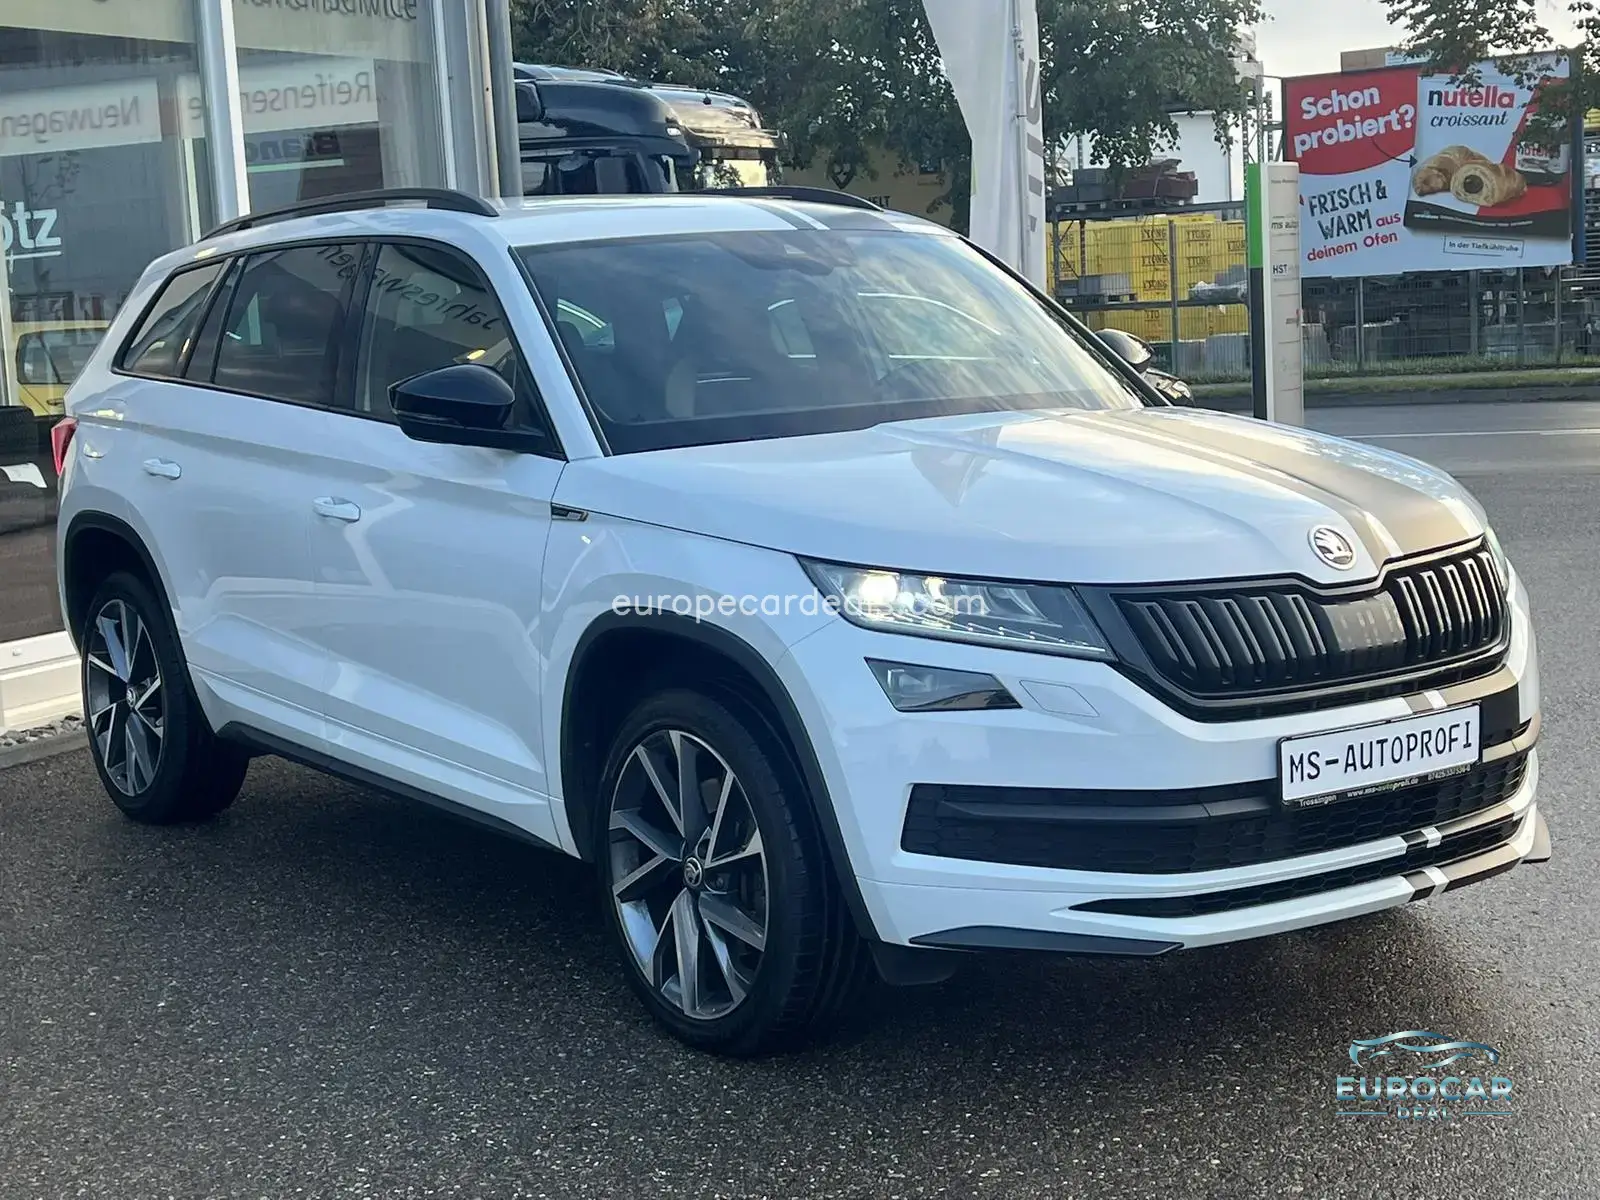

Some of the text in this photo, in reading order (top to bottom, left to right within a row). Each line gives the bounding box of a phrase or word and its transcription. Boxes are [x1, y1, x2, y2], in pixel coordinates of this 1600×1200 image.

[1301, 87, 1380, 119] Schon
[1428, 85, 1515, 108] nutella
[1294, 104, 1415, 158] probiert?
[1430, 111, 1508, 127] croissant
[1308, 179, 1388, 216] FRISCH &
[1317, 209, 1372, 240] WARM
[1376, 213, 1401, 227] aus
[1307, 232, 1398, 261] deinem Ofen
[1272, 264, 1288, 275] HST
[1290, 721, 1472, 783] MS-AUTOPROFI
[1299, 794, 1337, 807] Trossingen
